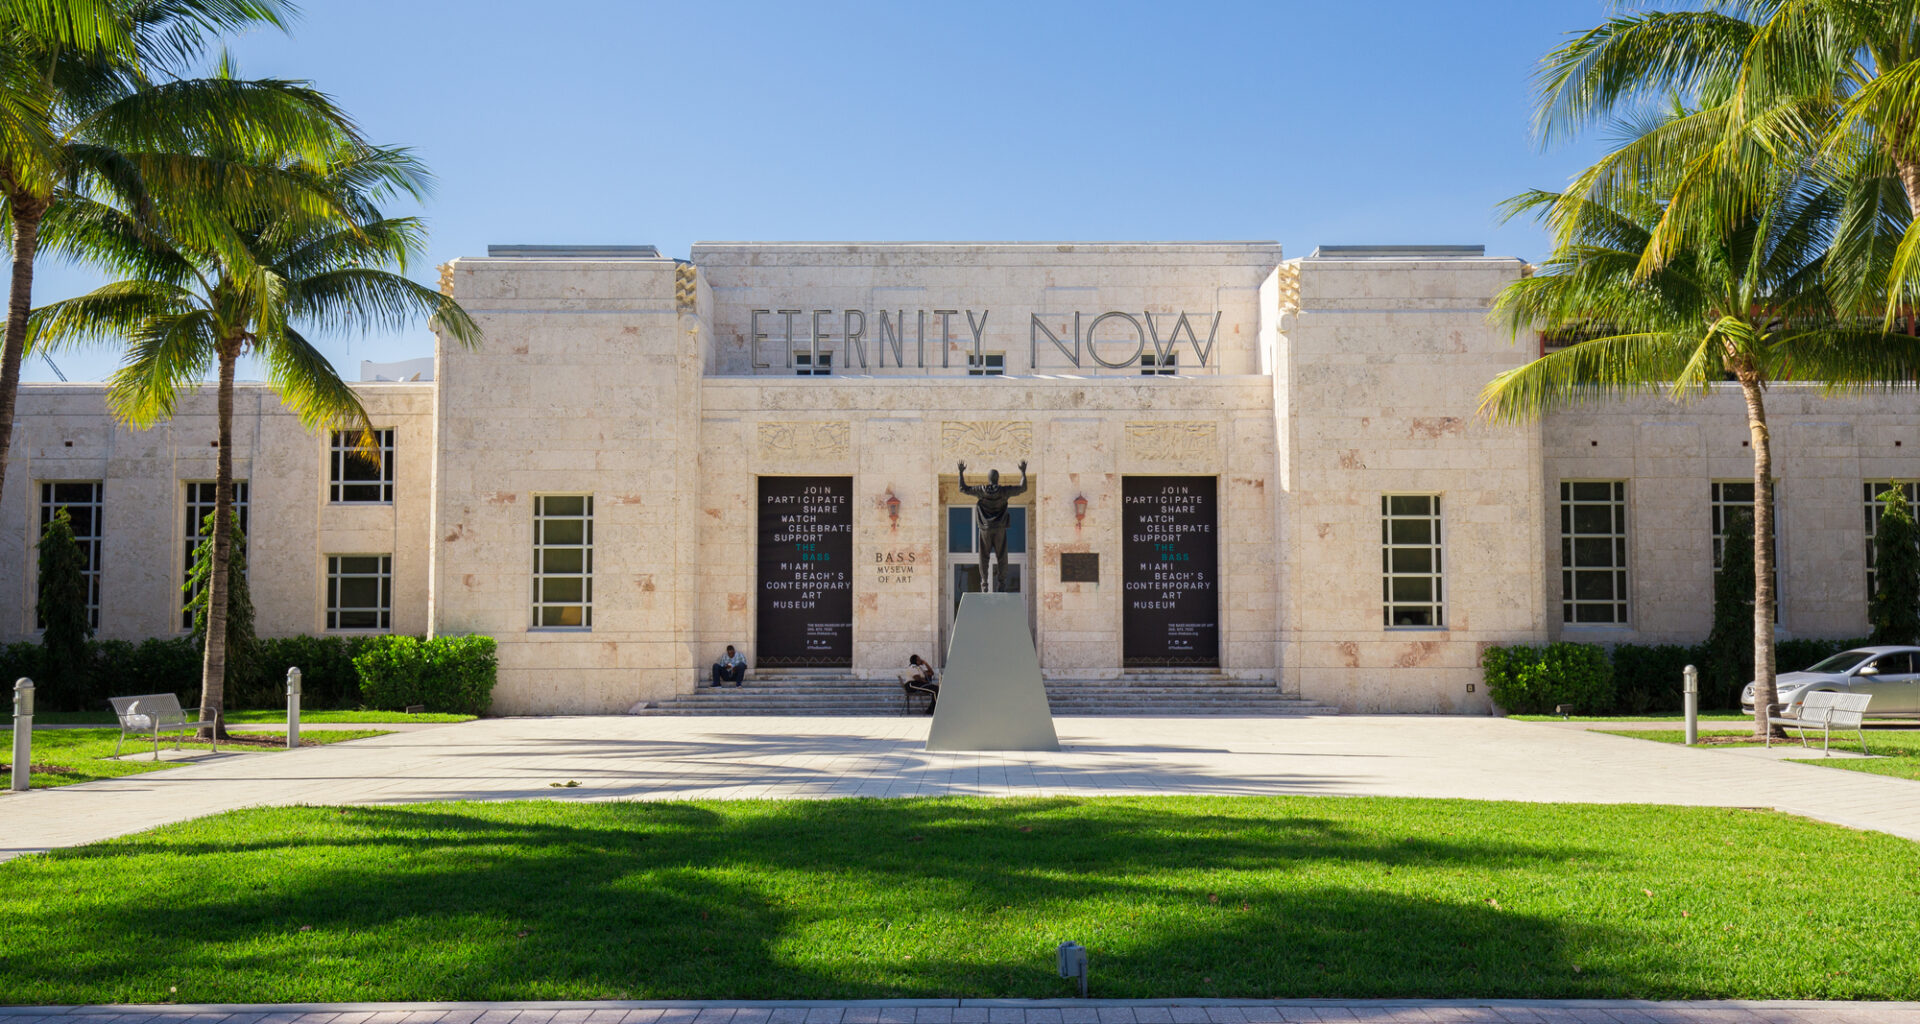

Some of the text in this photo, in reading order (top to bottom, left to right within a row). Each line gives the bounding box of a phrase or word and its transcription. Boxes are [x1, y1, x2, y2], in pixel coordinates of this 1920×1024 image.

[751, 309, 1223, 369] ETERNITY NOW
[803, 486, 831, 494] JOIN
[1161, 486, 1188, 494] JOIN
[767, 496, 845, 504] PARTICIPATE
[1125, 496, 1202, 504] PARTICIPATE
[802, 505, 838, 513] SHARE
[1161, 505, 1195, 513] SHARE
[781, 515, 817, 523] WATCH
[1139, 515, 1174, 523] WATCH
[788, 524, 852, 532] CELEBRATE
[1146, 524, 1210, 532] CELEBRATE
[774, 534, 823, 542] SUPPORT
[1133, 534, 1182, 542] SUPPORT
[796, 544, 815, 552] THE
[1154, 544, 1175, 552] THE
[802, 553, 830, 561] BASS
[875, 552, 916, 563] BASS
[1161, 553, 1189, 561] BASS
[780, 562, 814, 570] MIAMI
[1140, 562, 1173, 570] MIAMI
[795, 572, 844, 580] BEACH'S
[1154, 572, 1204, 580] BEACH'S
[766, 582, 851, 590] CONTEMPORARY
[1126, 582, 1210, 590] CONTEMPORARY
[801, 591, 822, 599] ART
[1161, 591, 1182, 599] ART
[773, 601, 815, 609] MUSEUM
[1133, 601, 1176, 609] MUSEUM
